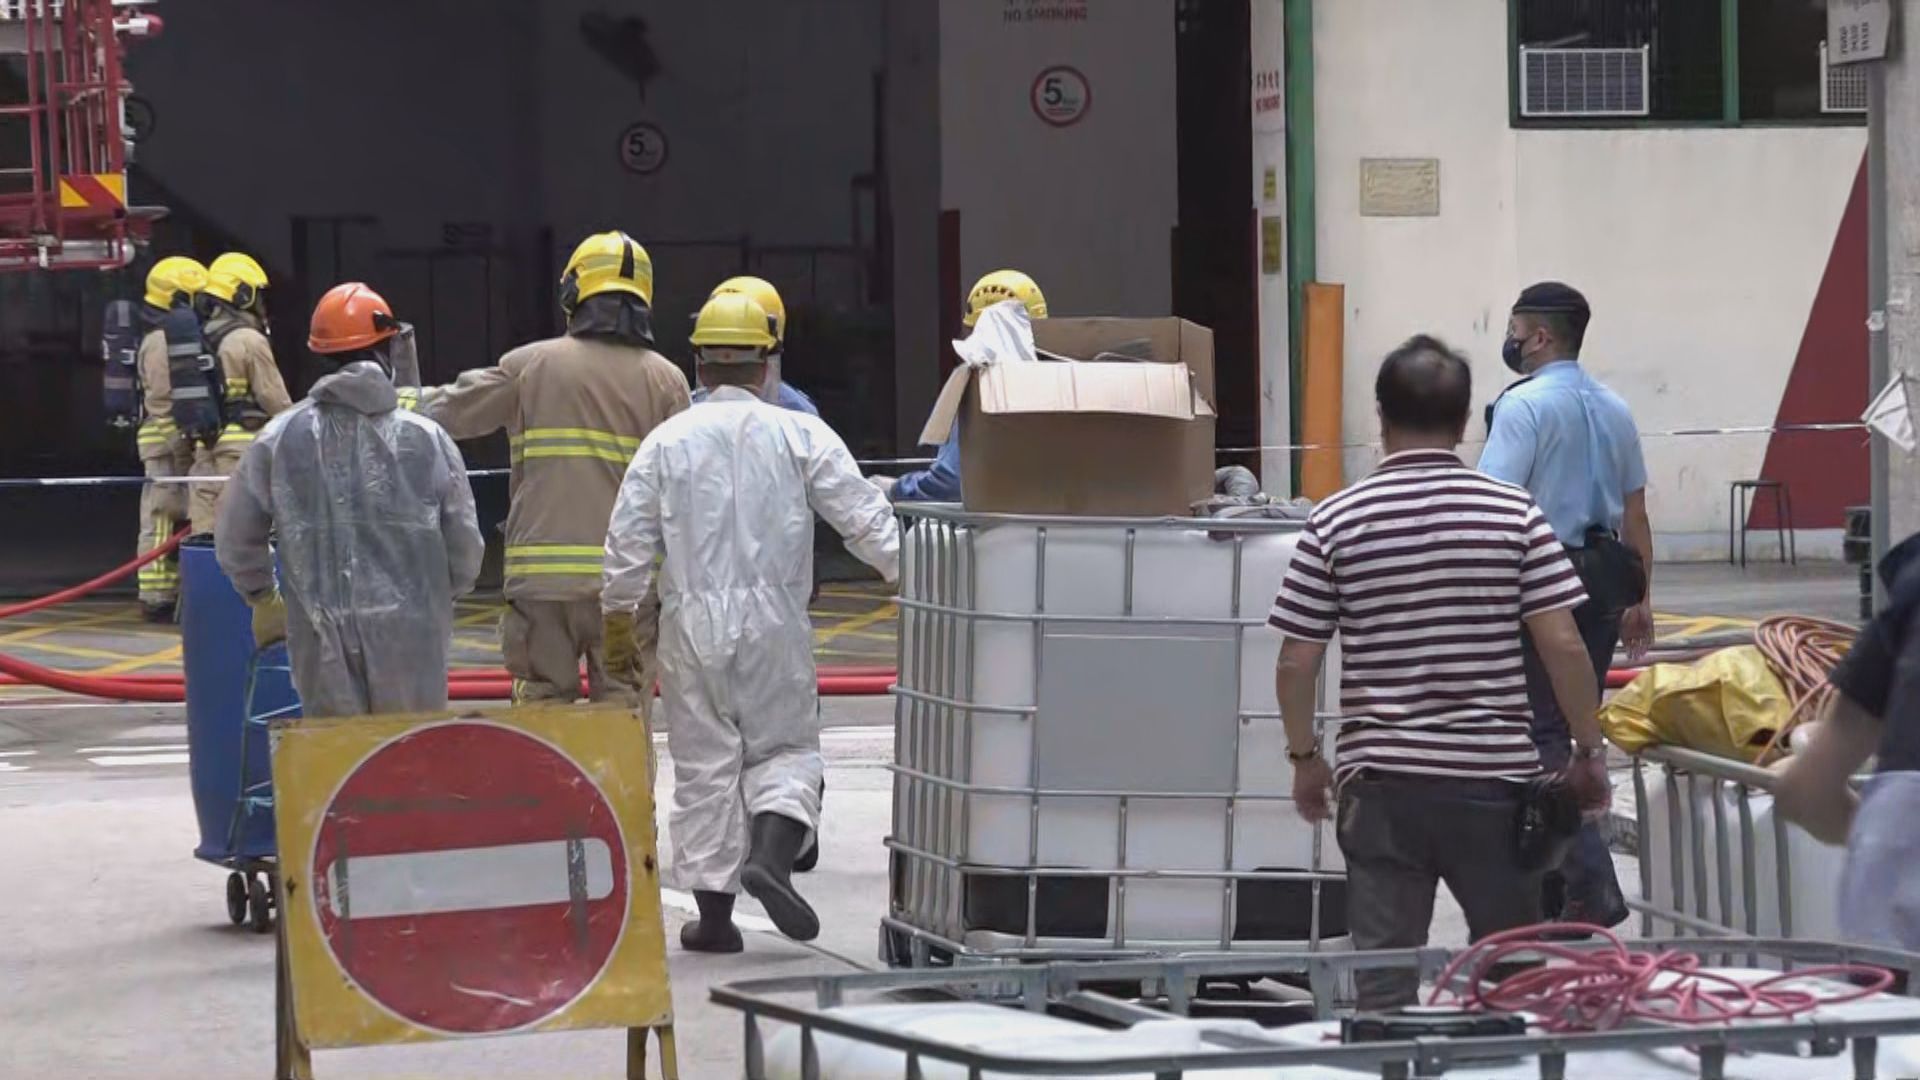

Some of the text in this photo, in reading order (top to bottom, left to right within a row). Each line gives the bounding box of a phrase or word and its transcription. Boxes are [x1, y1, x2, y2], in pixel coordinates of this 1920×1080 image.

[1003, 7, 1087, 22] NO SMOKING
[1044, 78, 1062, 105] 5
[629, 132, 645, 156] 5
